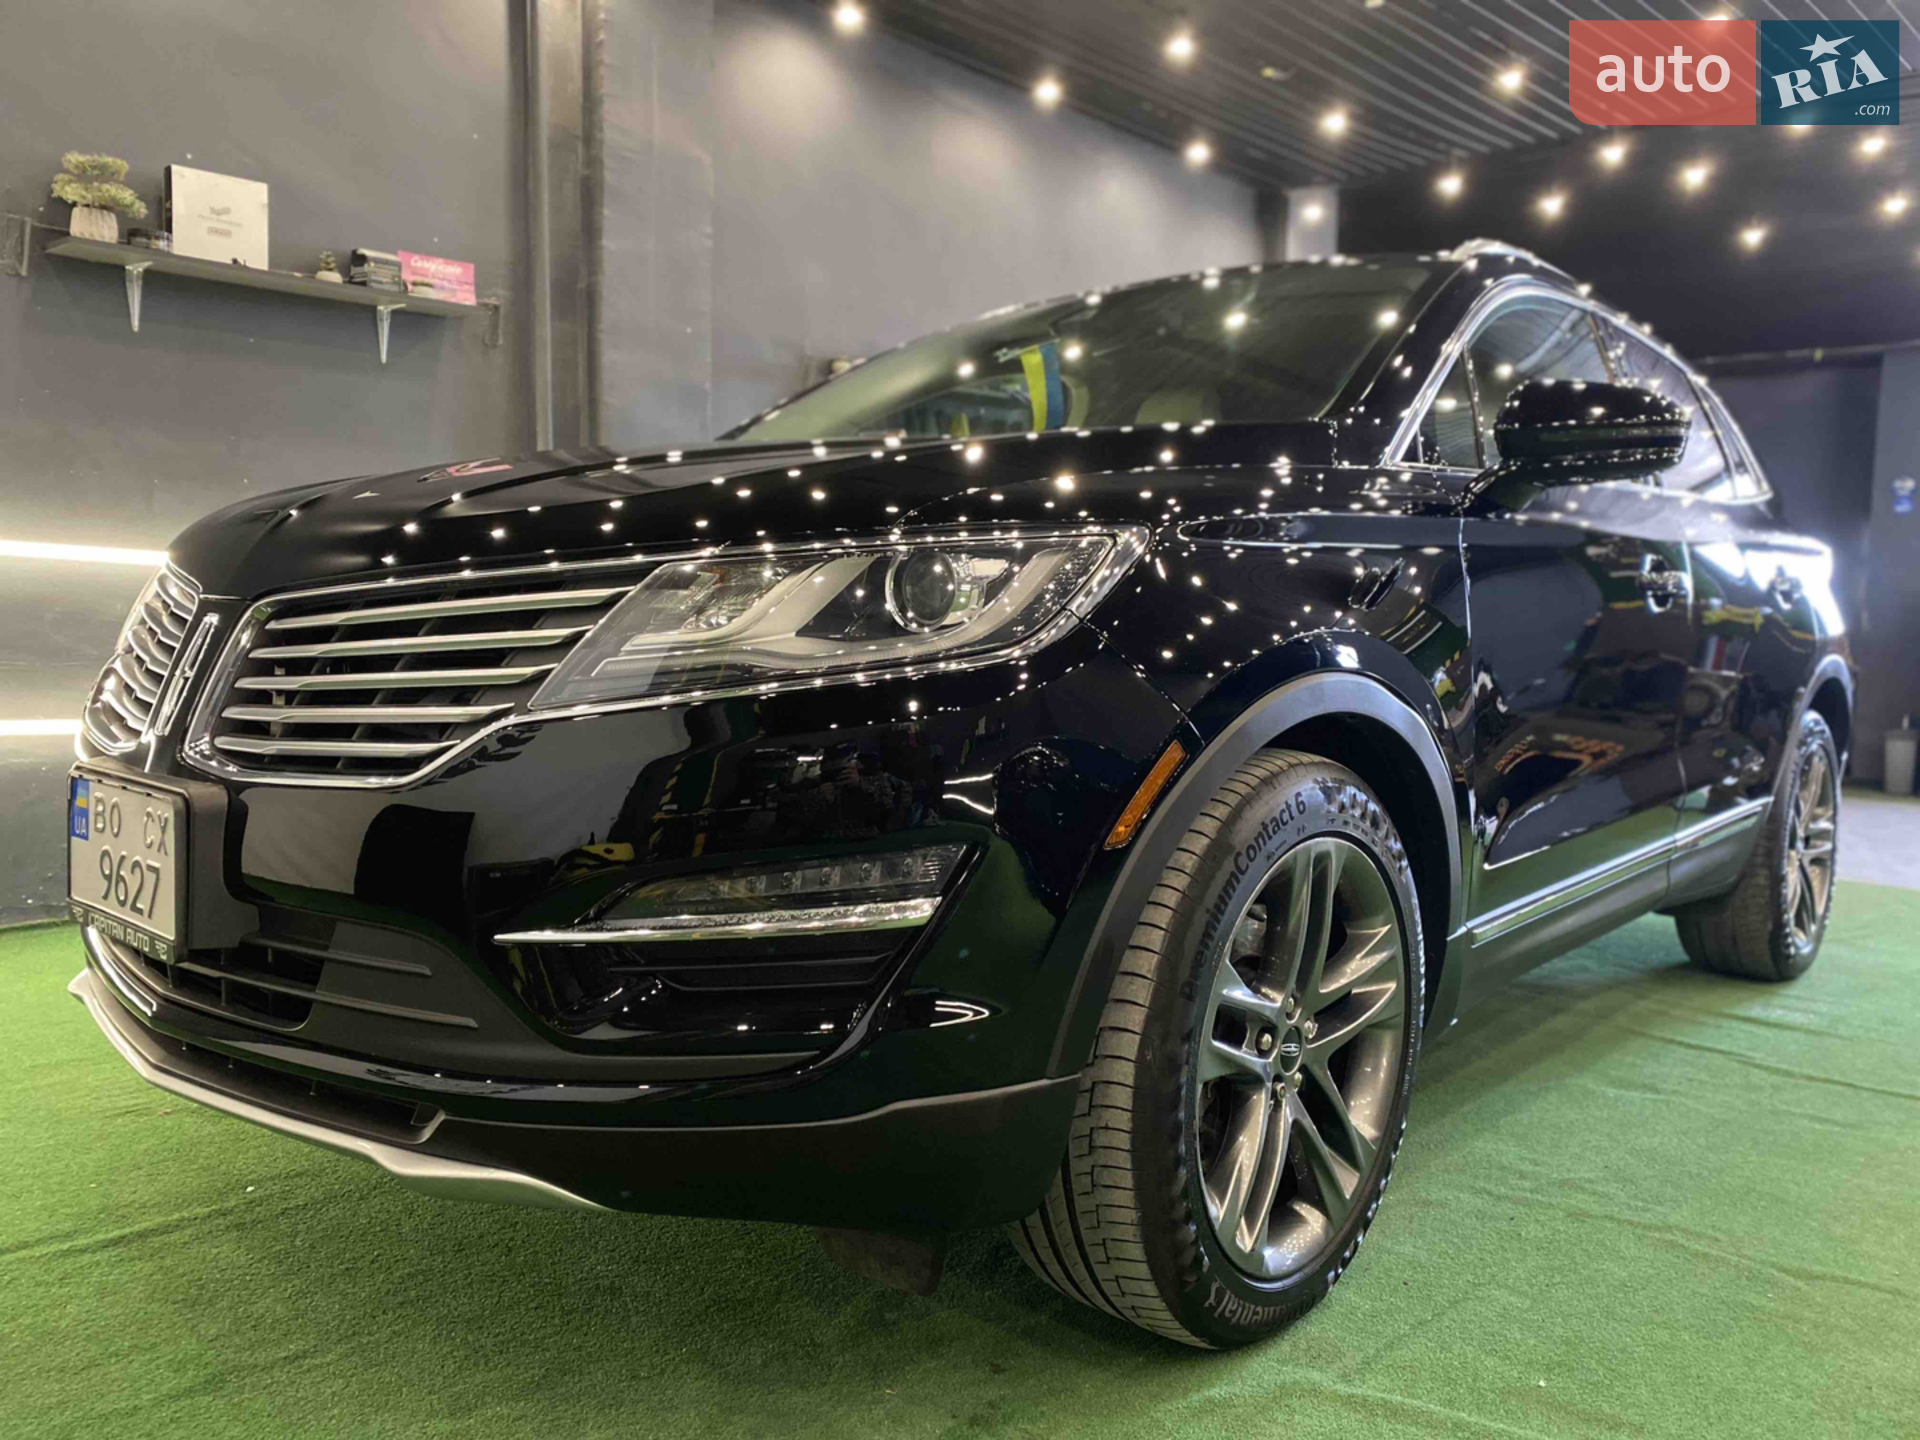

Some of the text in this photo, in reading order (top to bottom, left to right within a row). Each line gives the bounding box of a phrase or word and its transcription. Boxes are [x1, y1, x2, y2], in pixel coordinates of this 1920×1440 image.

[74, 815, 86, 836] UA
[94, 792, 169, 856] BO CX
[100, 845, 161, 919] 9627
[1180, 806, 1297, 1003] PremiumContact
[1296, 791, 1307, 815] 6
[125, 931, 150, 951] AUTO
